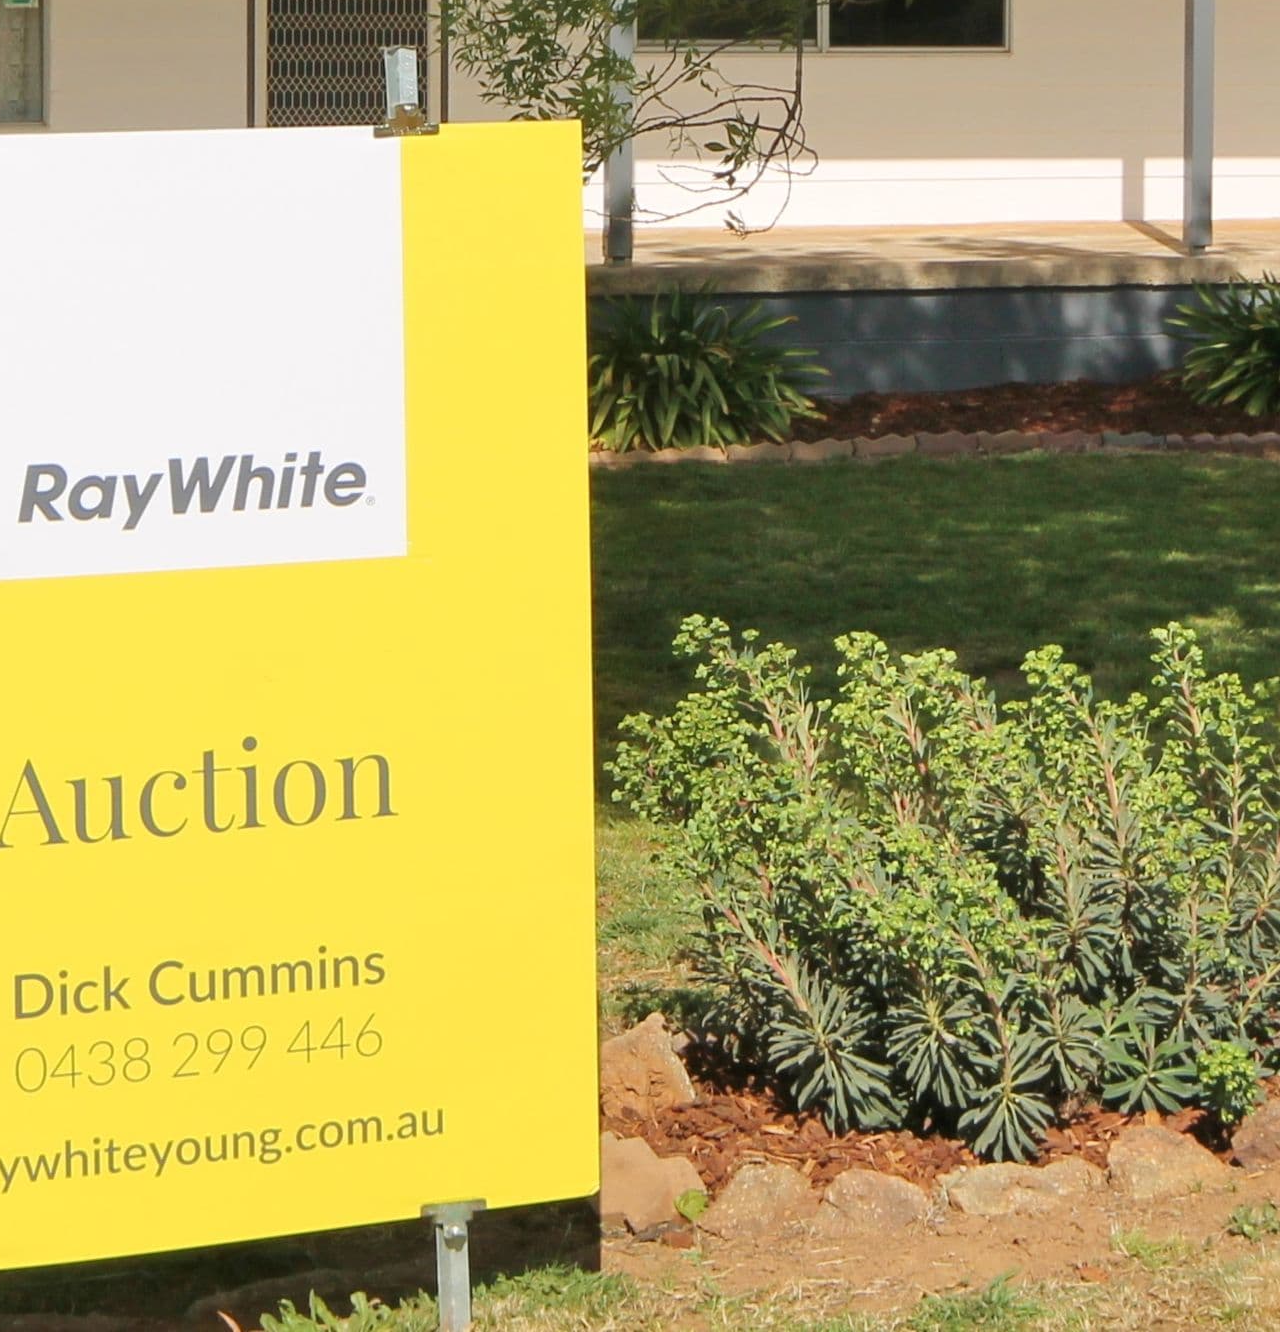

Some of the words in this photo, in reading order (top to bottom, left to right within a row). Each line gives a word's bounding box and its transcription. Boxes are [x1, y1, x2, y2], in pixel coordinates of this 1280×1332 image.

[14, 965, 131, 1020] Dick
[148, 945, 386, 1006] Cummins
[15, 1037, 151, 1093] 0438
[171, 1025, 267, 1079] 299
[286, 1012, 383, 1064] 446
